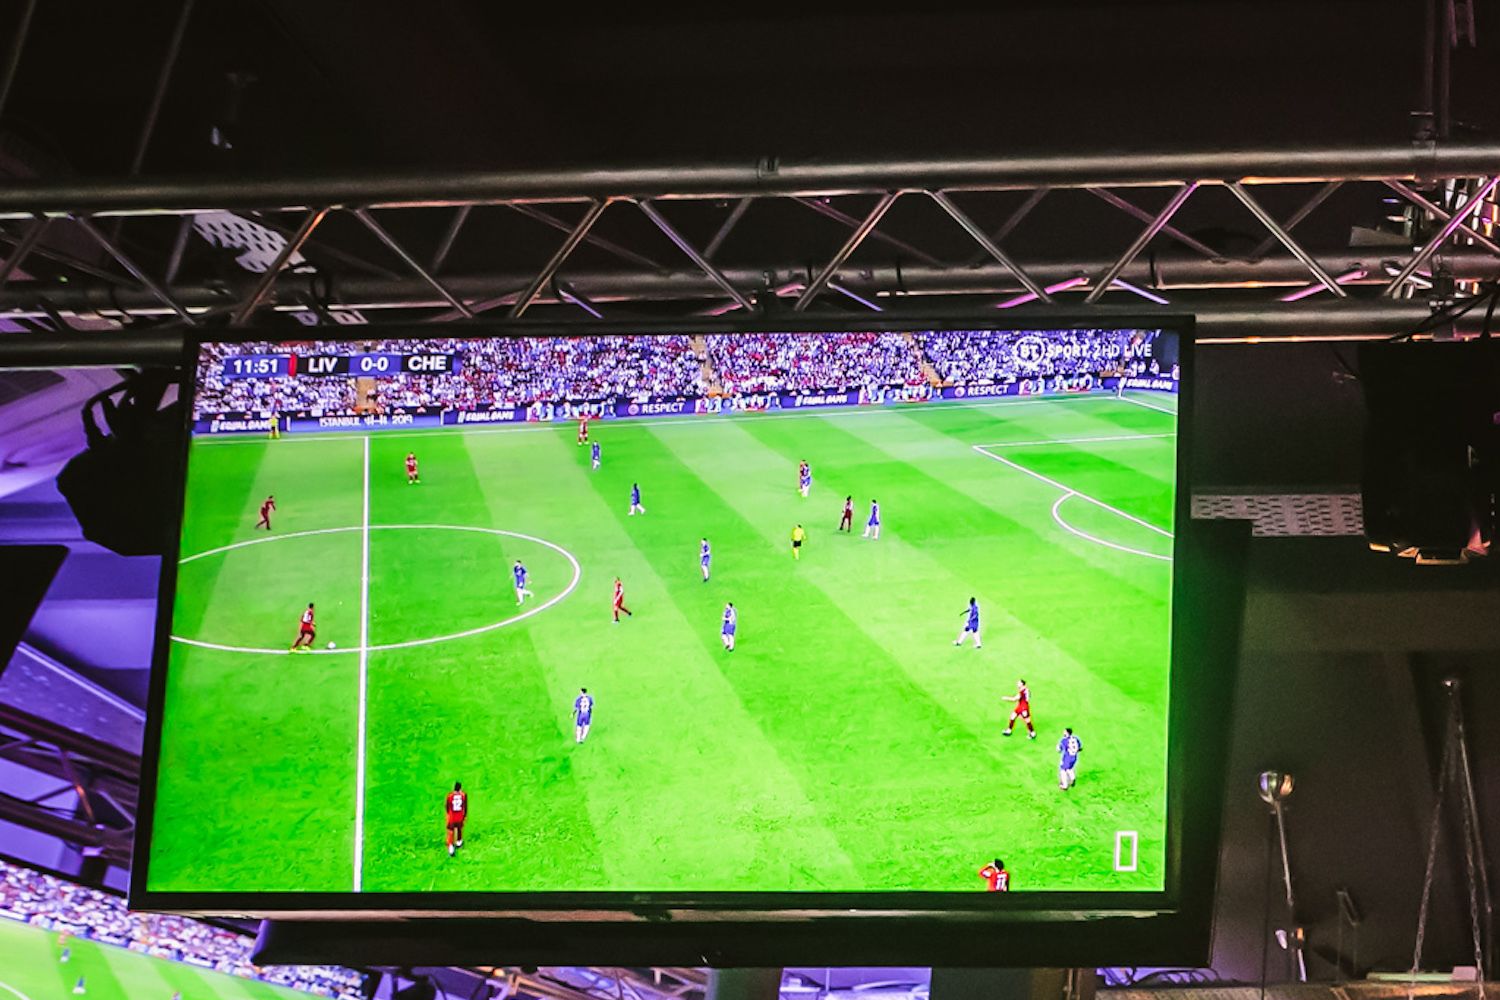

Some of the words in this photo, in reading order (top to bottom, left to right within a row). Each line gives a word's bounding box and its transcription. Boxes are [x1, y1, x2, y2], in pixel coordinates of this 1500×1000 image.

[1047, 342, 1086, 358] SPORT
[1124, 343, 1153, 357] LIVE
[233, 358, 278, 375] 11:51
[307, 357, 338, 373] LIV
[360, 356, 389, 372] 0-0
[407, 355, 447, 371] CHE
[967, 384, 1009, 397] RESPECT
[641, 401, 684, 414] RESPECT
[319, 417, 361, 428] ISTANBUL
